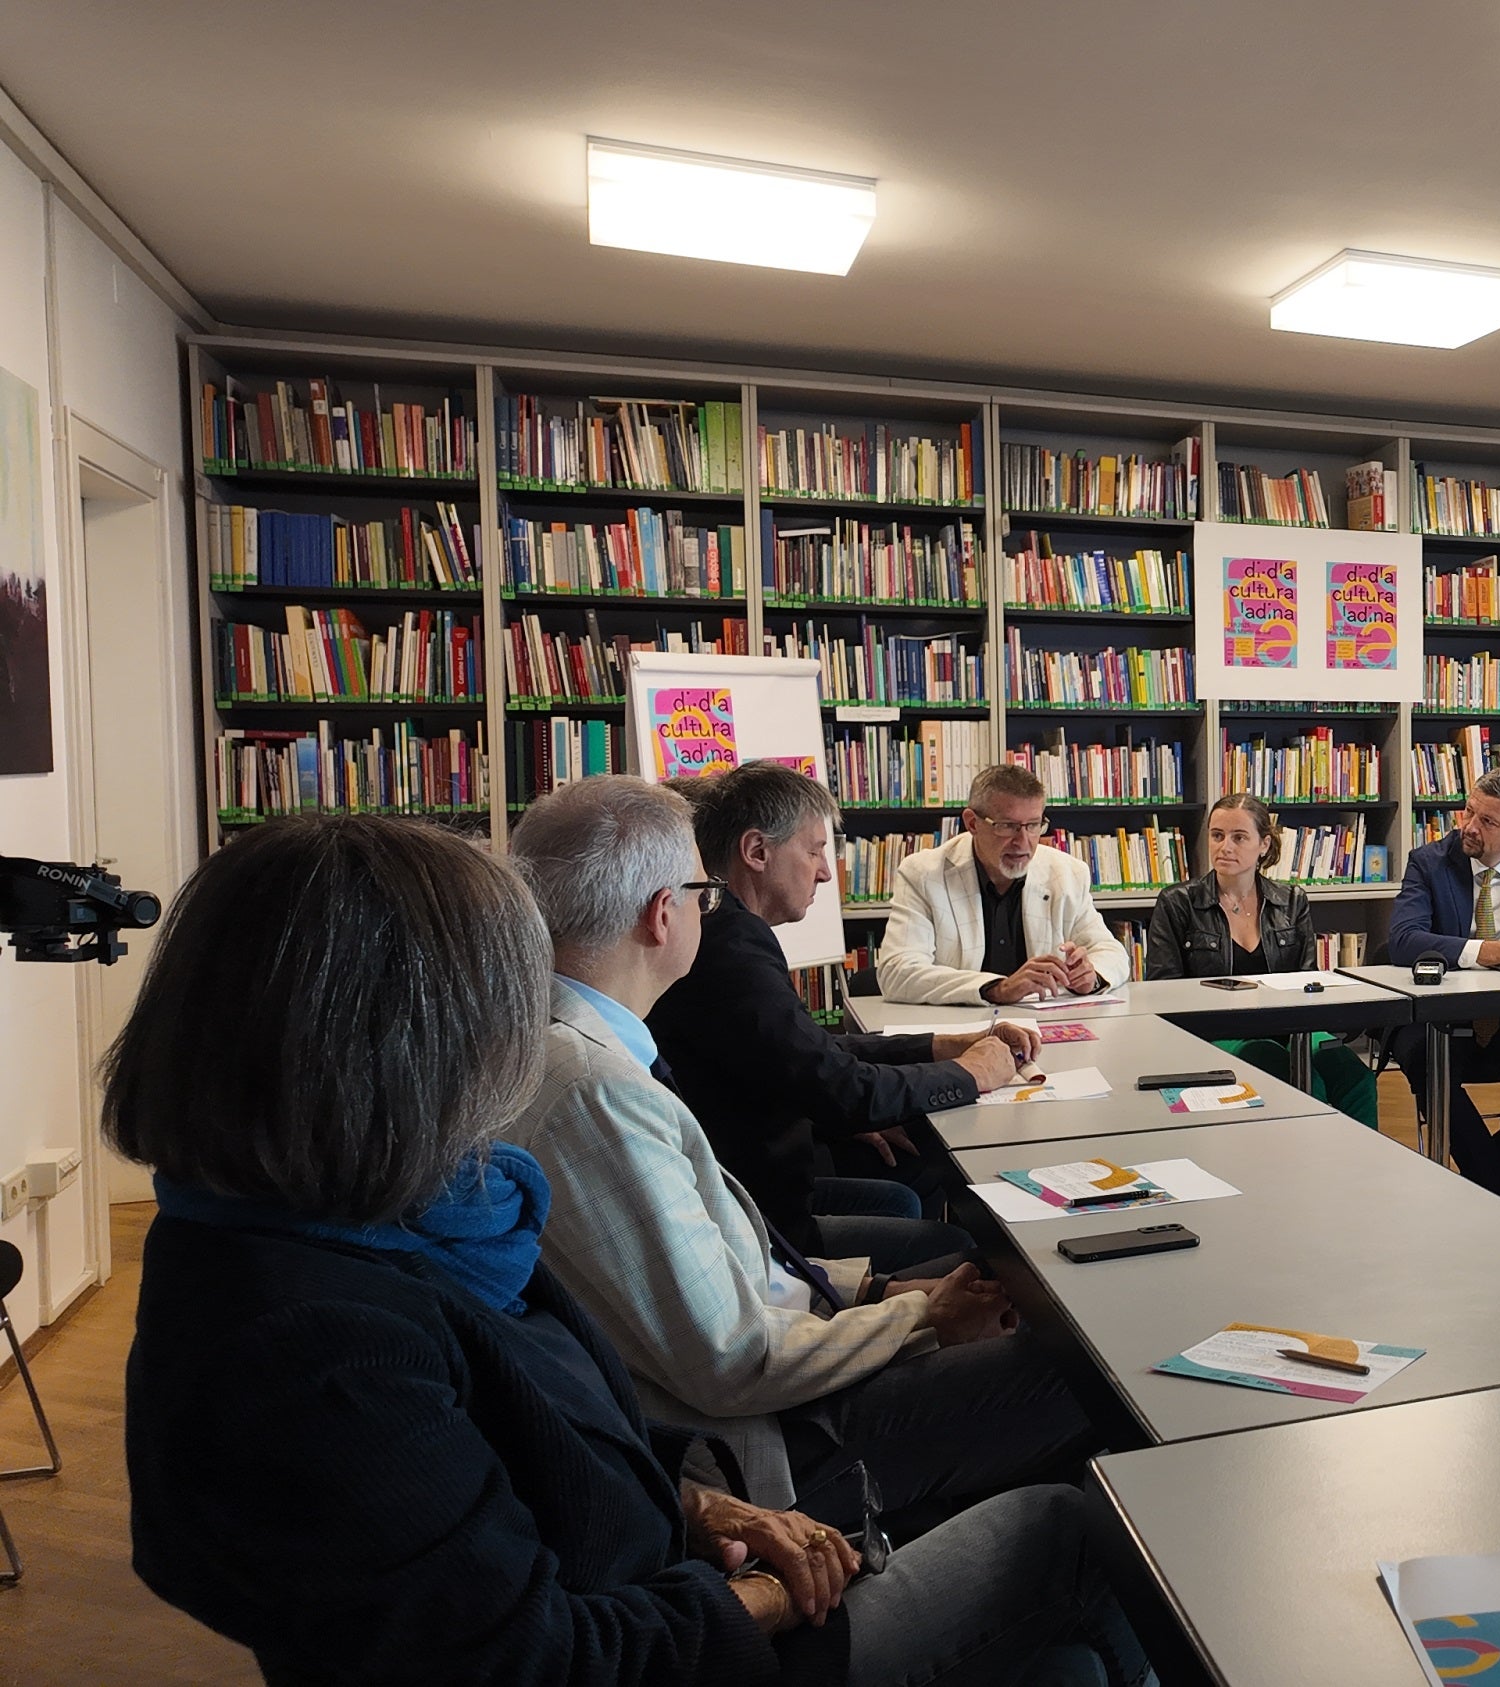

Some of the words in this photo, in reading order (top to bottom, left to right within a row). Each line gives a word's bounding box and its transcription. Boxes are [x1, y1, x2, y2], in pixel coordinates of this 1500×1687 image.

[1229, 580, 1294, 600] cultura
[1332, 585, 1394, 604] cultura
[1240, 602, 1295, 620] ladina
[1343, 605, 1394, 623] ladina
[659, 716, 731, 738] cultura
[674, 742, 735, 764] ladina
[37, 865, 91, 890] RONIN
